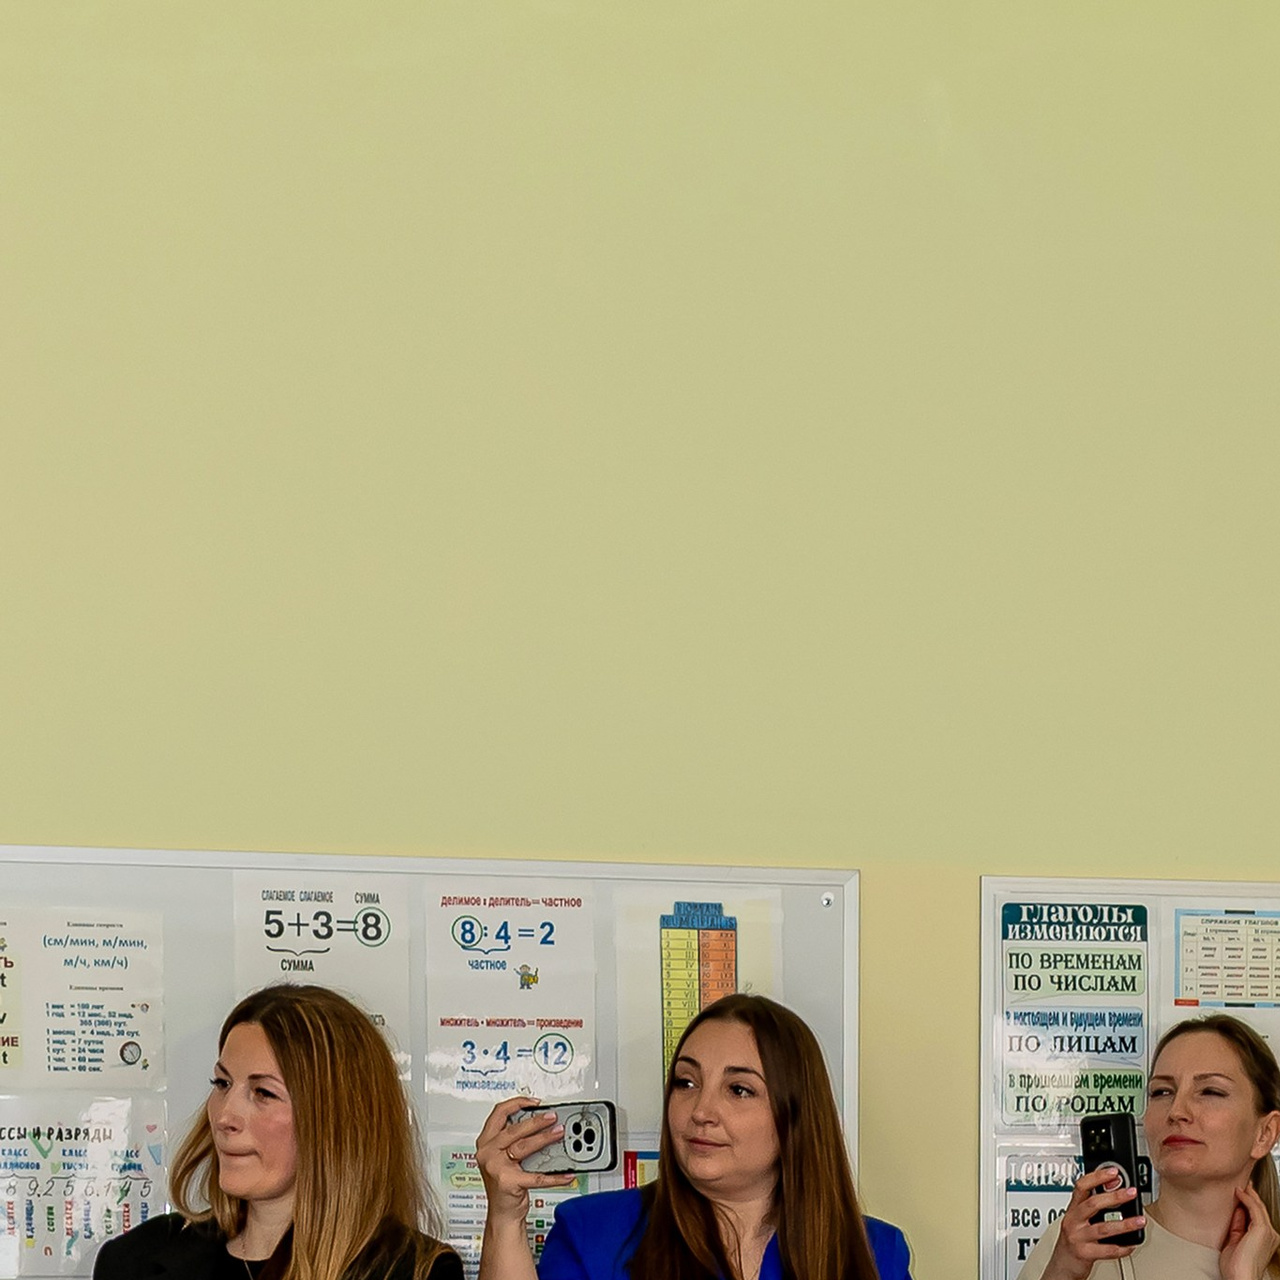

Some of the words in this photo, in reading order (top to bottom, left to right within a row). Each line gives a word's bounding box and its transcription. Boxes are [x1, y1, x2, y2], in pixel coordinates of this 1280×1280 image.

[261, 890, 295, 902] СЛАГАЕМОЕ
[299, 891, 334, 903] СЛАГАЕМОЕ
[354, 892, 380, 904] СУММА
[441, 896, 482, 908] делимое
[541, 896, 582, 908] частное
[43, 934, 99, 949] (см/мин,
[102, 935, 148, 950] м/мин,
[63, 955, 90, 969] м/ч,
[93, 956, 128, 970] км/ч)
[280, 958, 314, 971] СУММА
[468, 958, 507, 971] частное
[1008, 952, 1033, 970] ПО
[1039, 953, 1142, 971] ВРЕМЕНАМ
[1013, 974, 1041, 991] ПО
[1050, 974, 1137, 992] ЧИСЛАМ
[1008, 1035, 1041, 1052] ПО
[1051, 1035, 1138, 1054] ЛИЦАМ
[1093, 1073, 1143, 1095] времени
[1015, 1095, 1047, 1112] ПО
[1056, 1095, 1135, 1114] РОДАМ
[32, 1126, 41, 1140] И
[47, 1126, 113, 1143] РАЗРЯДЫ
[1010, 1208, 1041, 1228] все
